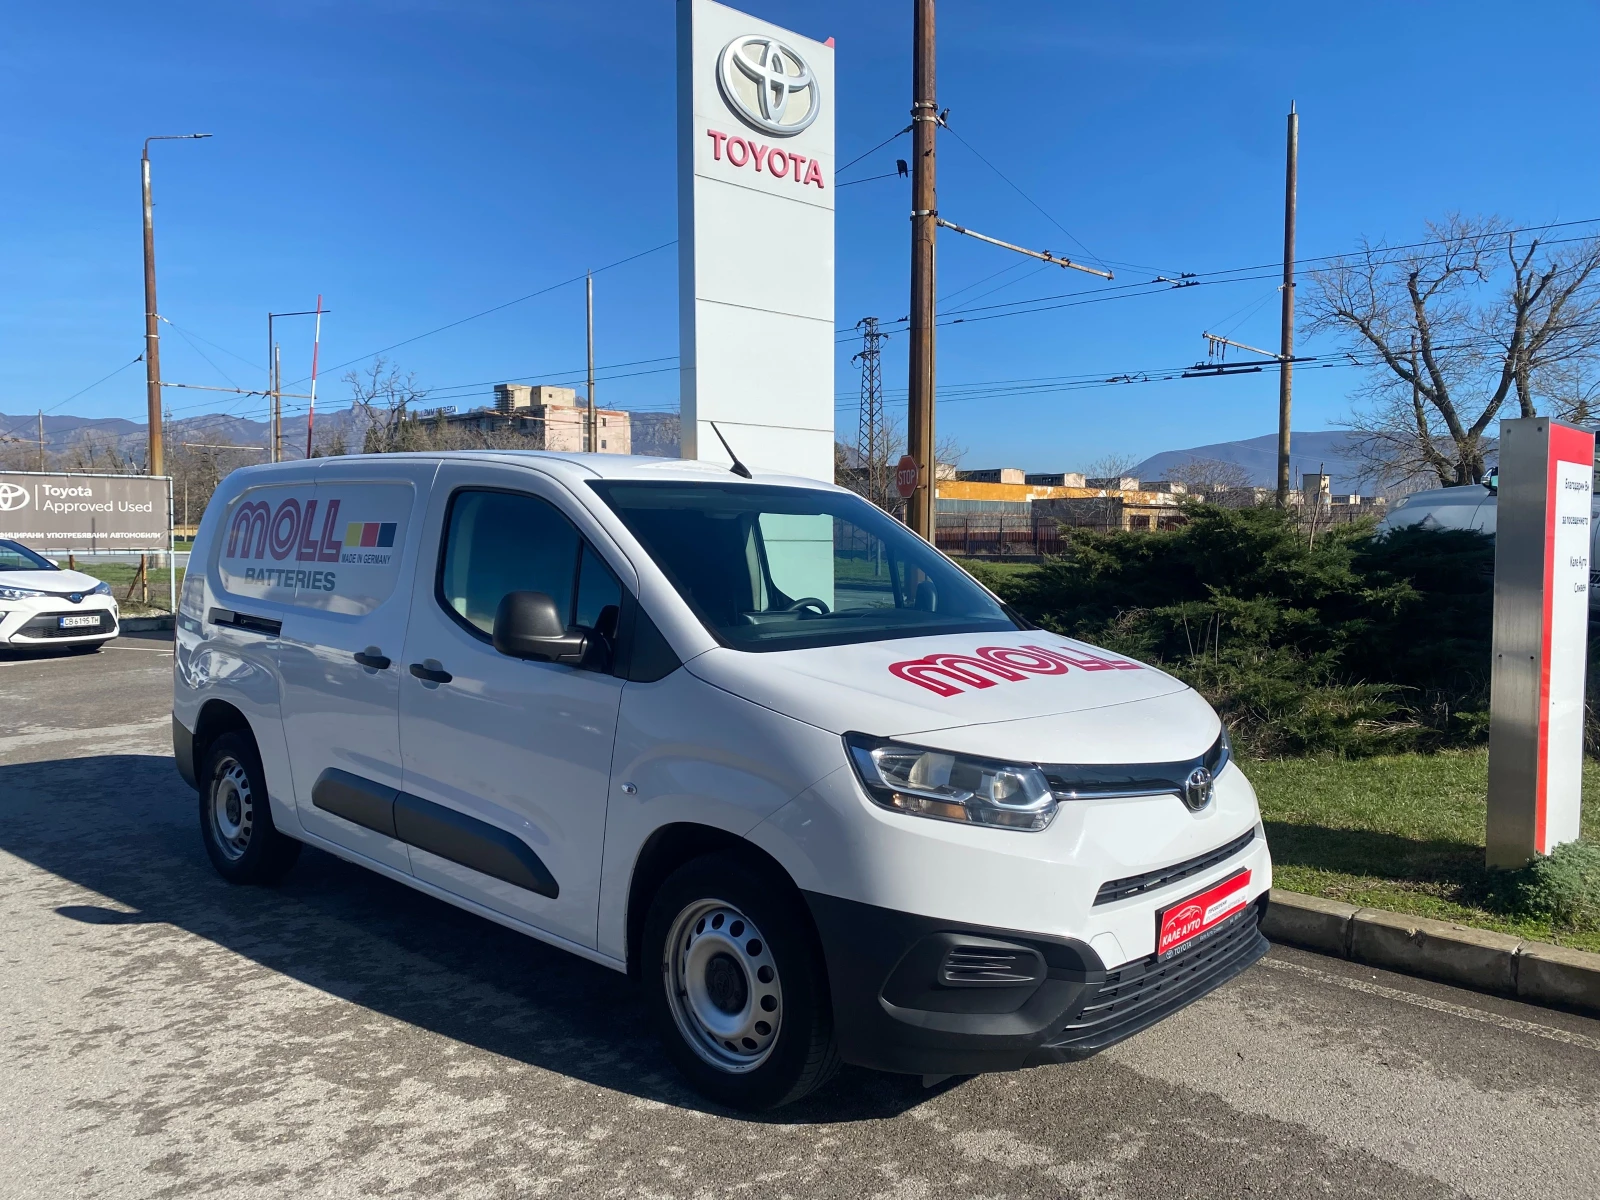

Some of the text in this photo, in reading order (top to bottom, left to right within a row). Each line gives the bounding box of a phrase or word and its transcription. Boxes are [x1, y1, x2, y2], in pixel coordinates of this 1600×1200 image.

[707, 129, 824, 189] TOYOTA
[898, 469, 916, 486] STOP
[42, 484, 93, 499] Toyota
[43, 500, 153, 514] Approved Used
[341, 553, 392, 565] MADE IN GERMANY
[244, 568, 336, 592] BATTERIES
[1162, 928, 1181, 947] КАЛЕ
[1181, 918, 1201, 936] АУТО
[1173, 941, 1192, 955] TOYOTA
